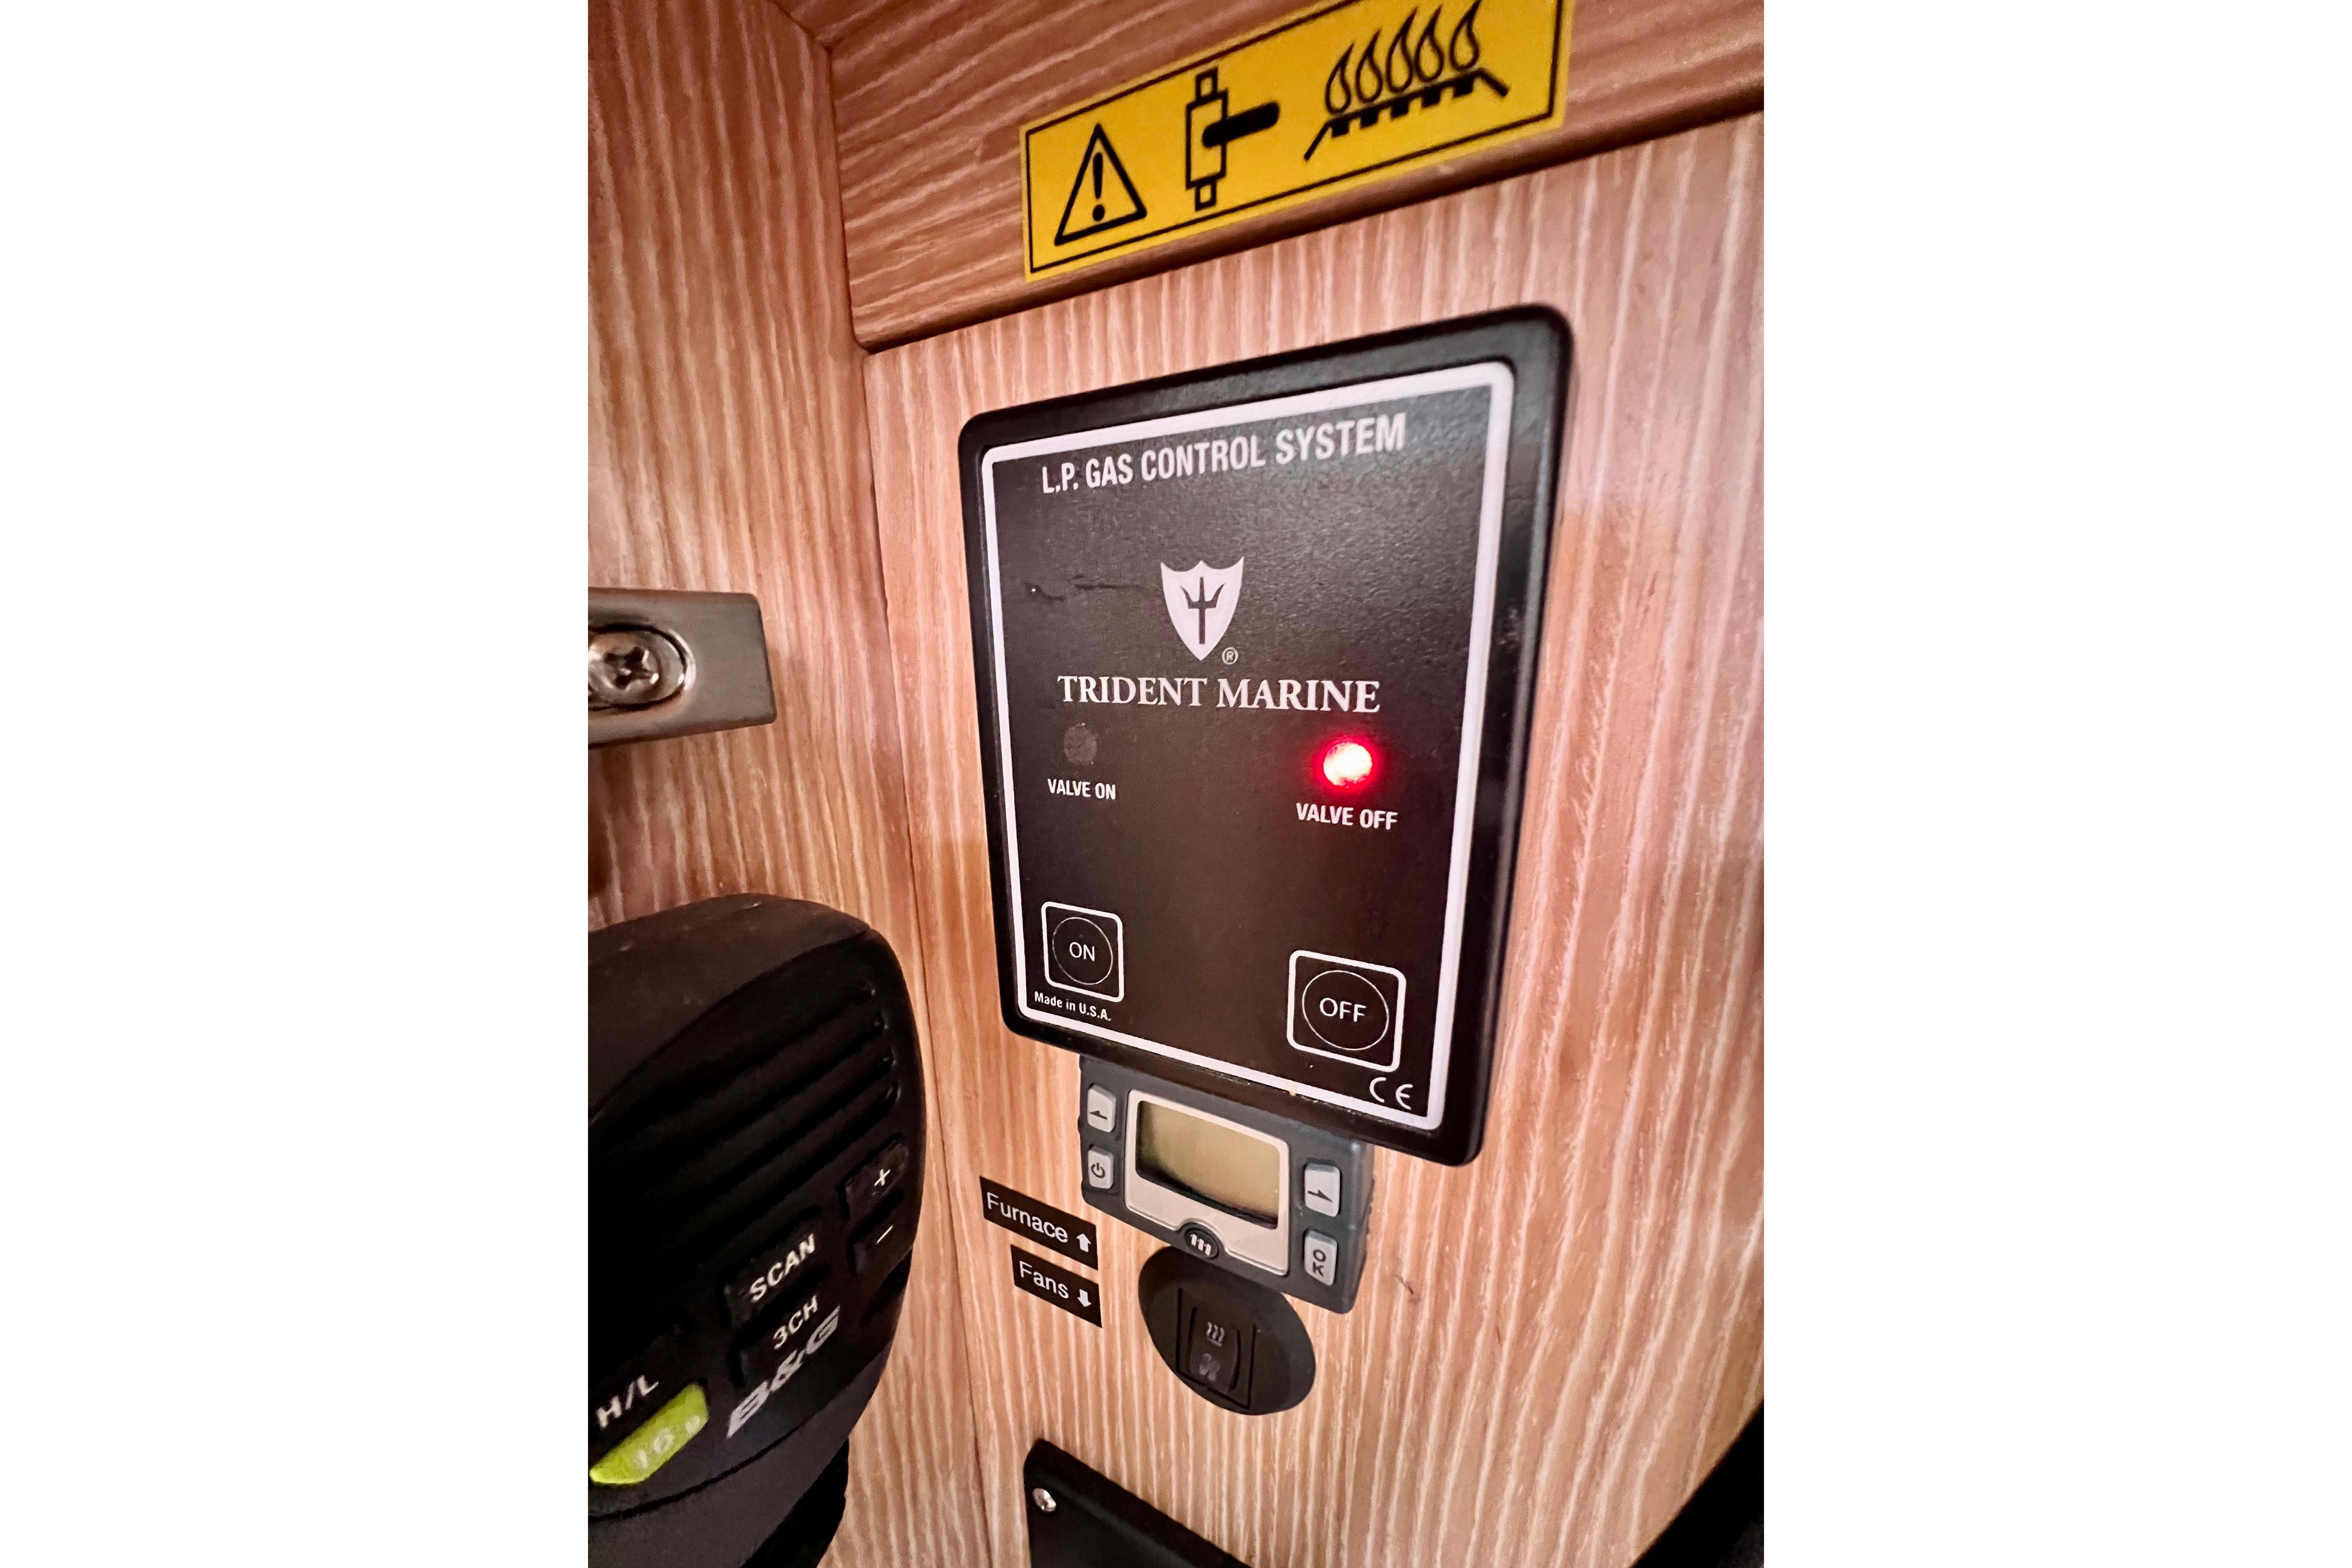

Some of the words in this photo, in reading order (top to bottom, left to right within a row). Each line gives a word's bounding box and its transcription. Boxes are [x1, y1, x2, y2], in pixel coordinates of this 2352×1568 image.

[1042, 462, 1079, 494] L.P.
[1086, 453, 1133, 489] GAS
[1141, 434, 1265, 479] CONTROL
[1276, 412, 1406, 465] SYSTEM
[1057, 676, 1208, 707] TRIDENT
[1217, 679, 1380, 713] MARINE
[1047, 779, 1091, 798] VALVE
[1095, 782, 1116, 800] ON
[1296, 802, 1354, 826] VALVE
[1360, 809, 1398, 830] OFF
[1034, 991, 1062, 1008] Made
[1066, 999, 1076, 1011] in
[1078, 1002, 1111, 1021] U.S.A.
[1069, 941, 1096, 962] ON
[1319, 997, 1367, 1023] OFF
[987, 1192, 1068, 1243] Furnace
[749, 1233, 816, 1303] SCAN
[1018, 1260, 1069, 1299] Fans
[1311, 1248, 1327, 1276] OK
[773, 1295, 817, 1349] 3CH
[727, 1306, 840, 1439] B&G
[597, 1375, 659, 1428] H/L
